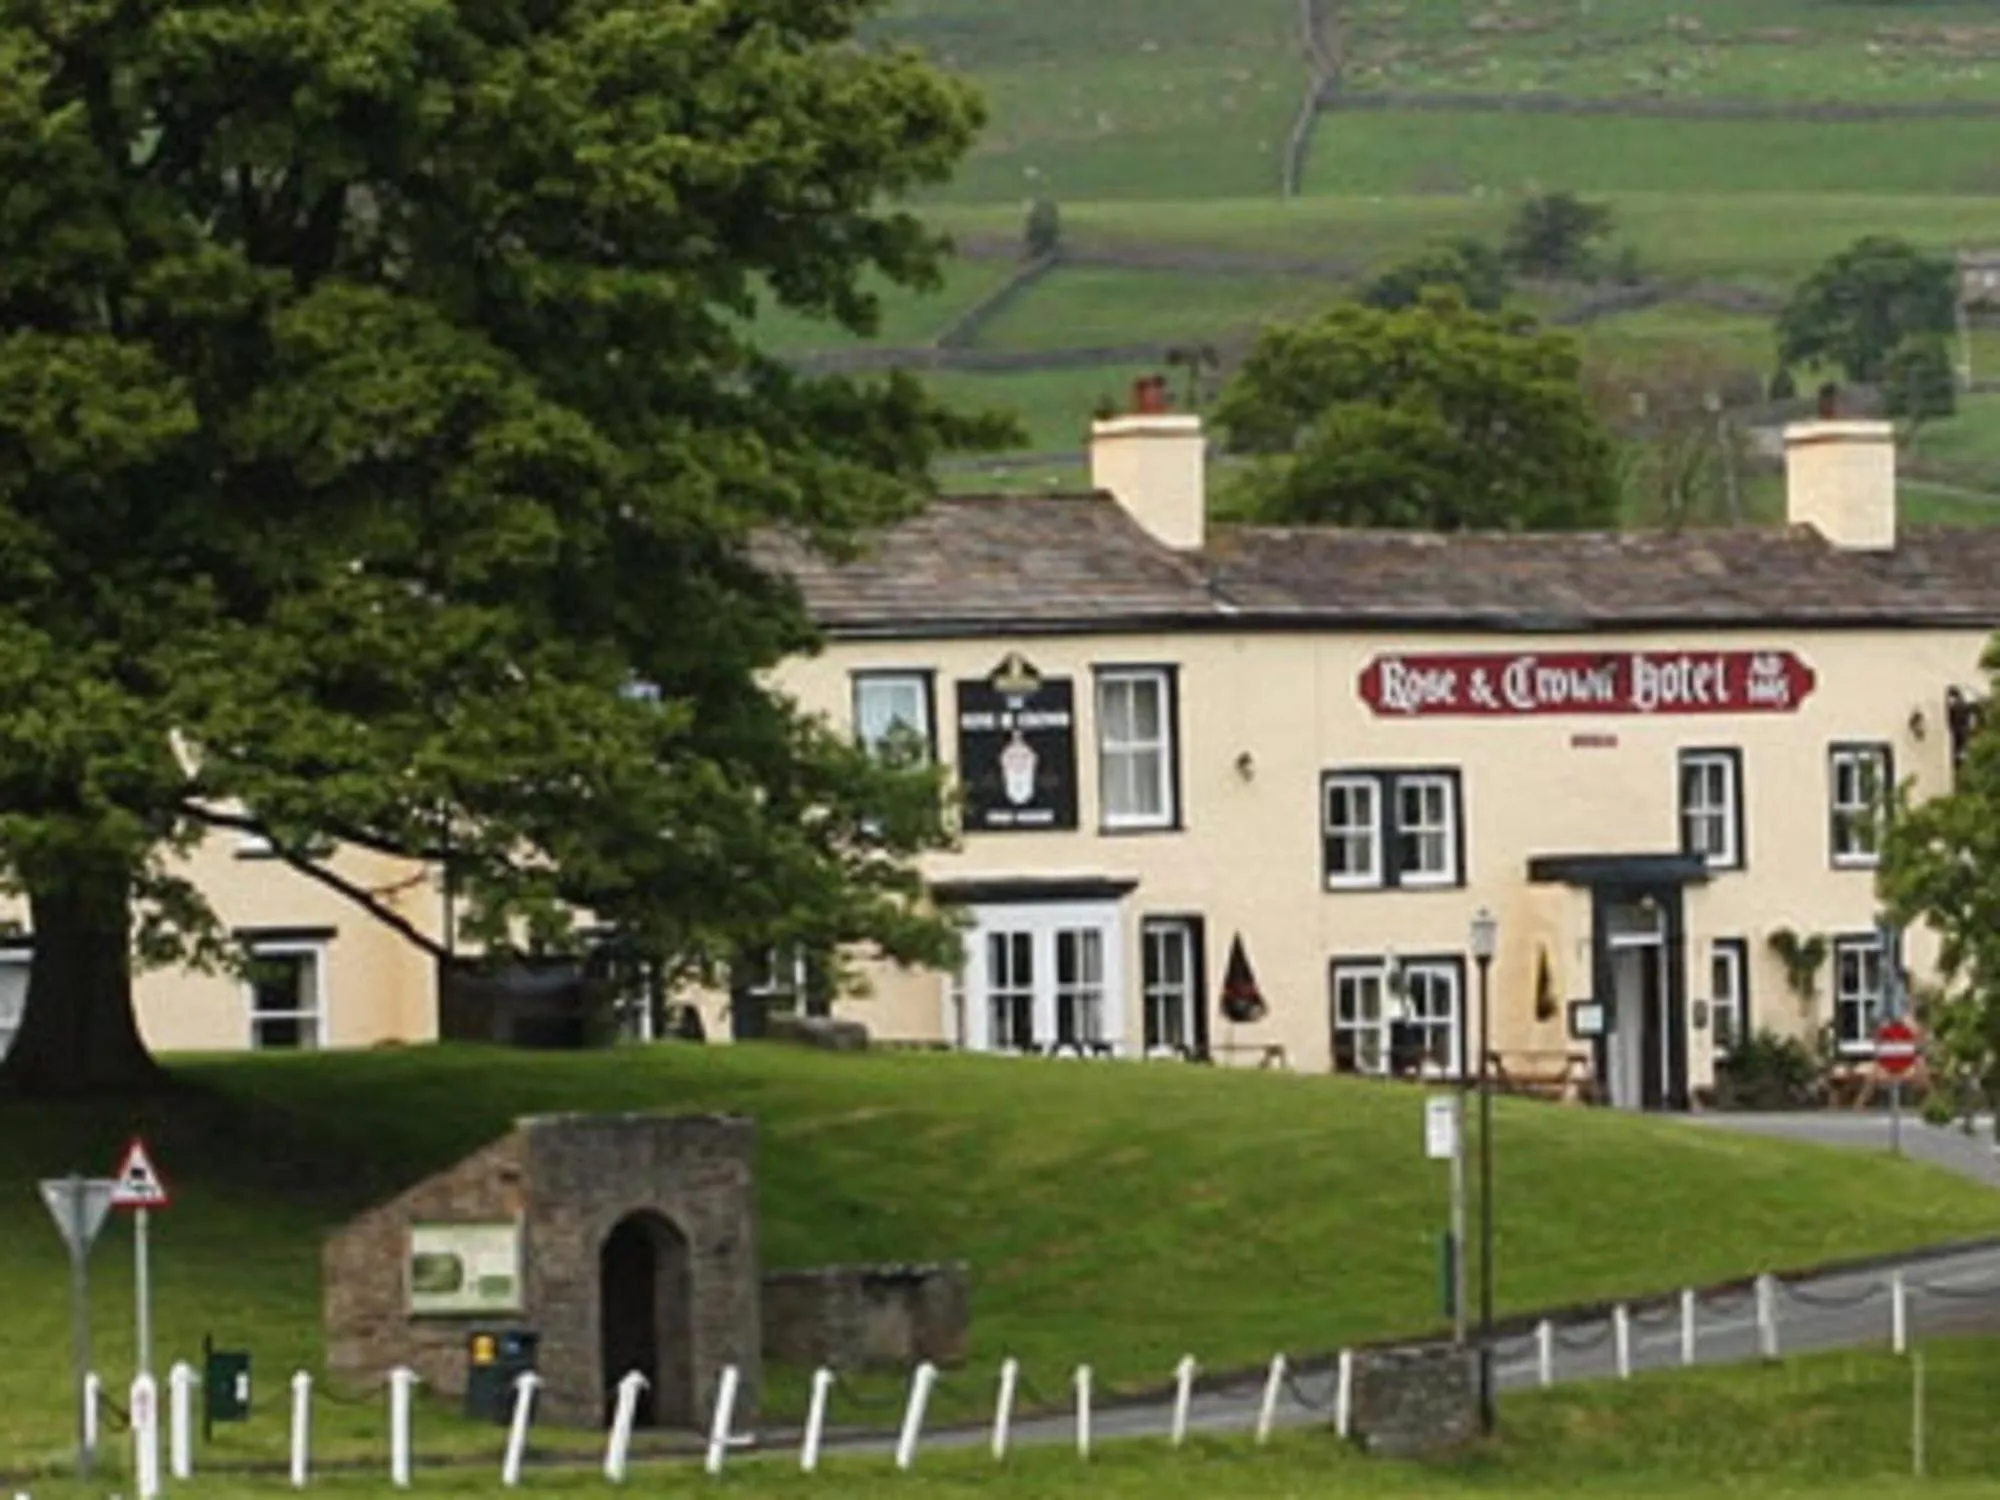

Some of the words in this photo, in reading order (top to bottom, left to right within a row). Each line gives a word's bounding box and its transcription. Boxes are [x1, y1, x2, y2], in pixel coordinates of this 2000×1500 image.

[1380, 661, 1457, 711] Rose
[1468, 667, 1500, 709] &
[1502, 655, 1616, 709] Crown
[1631, 653, 1729, 711] Hotel
